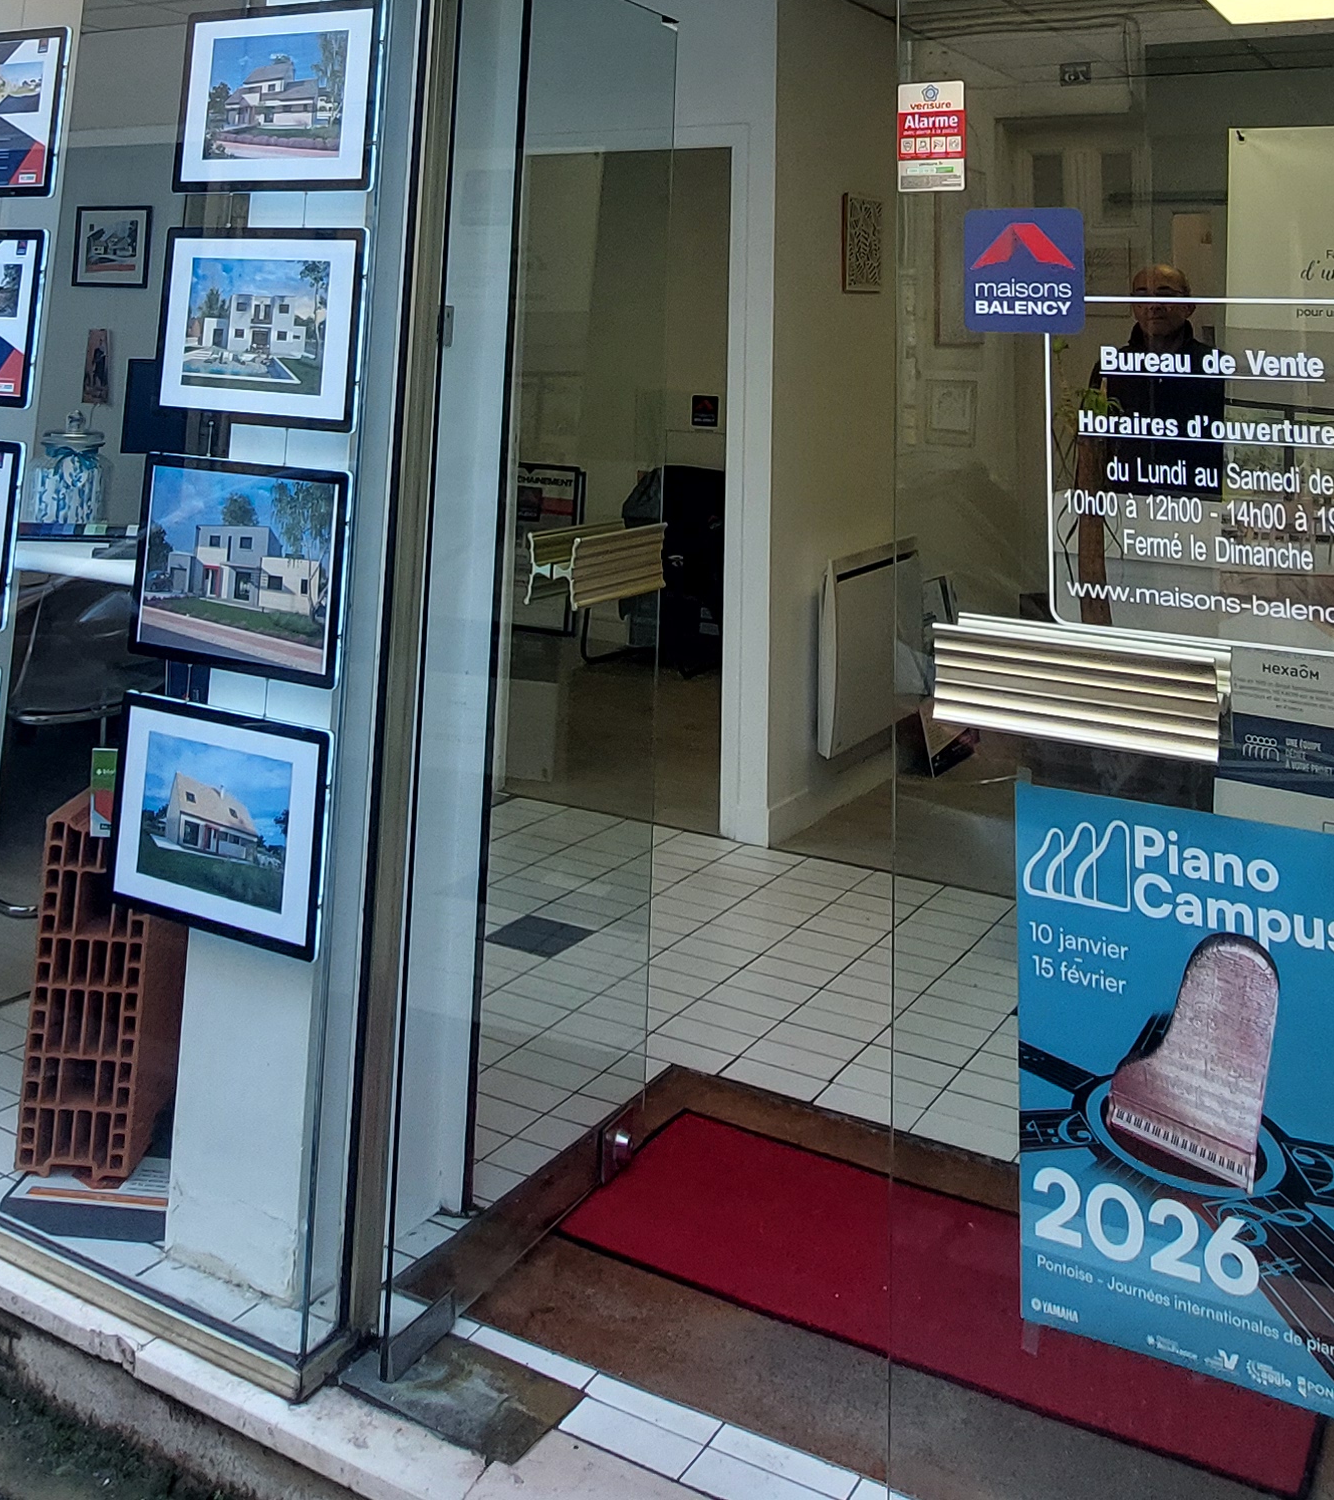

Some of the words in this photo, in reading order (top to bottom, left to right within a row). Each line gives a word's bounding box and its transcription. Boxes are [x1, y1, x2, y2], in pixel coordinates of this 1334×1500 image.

[904, 114, 959, 130] Alarme
[910, 102, 951, 111] verisure
[974, 278, 1073, 298] maisons
[975, 300, 1072, 315] BALENCY
[1296, 308, 1324, 319] pour
[1100, 346, 1192, 373] Bureau
[1201, 350, 1236, 375] de
[1245, 350, 1325, 378] Vente
[1078, 410, 1179, 437] Horaires
[1106, 457, 1129, 482] du
[1137, 458, 1187, 486] Lundi
[1195, 466, 1218, 488] au
[1226, 463, 1301, 494] Samedi
[1309, 469, 1334, 496] de
[1063, 489, 1118, 517] 10h00
[1125, 498, 1138, 519] à
[1146, 494, 1203, 523] 12h00
[1227, 501, 1286, 530] 14h00
[1295, 505, 1308, 532] à
[1123, 529, 1183, 559] Fermé
[1190, 534, 1207, 561] le
[1215, 537, 1314, 571] Dimanche
[1134, 825, 1279, 892] Piano
[1029, 921, 1053, 945] 10
[1058, 927, 1129, 962] janvier
[1032, 956, 1054, 979] 15
[1061, 958, 1127, 994] février
[1032, 1166, 1260, 1296] 2026
[1036, 1254, 1094, 1284] Pontoise
[1107, 1276, 1171, 1307] Journées
[1173, 1296, 1280, 1340] internationales
[1283, 1327, 1304, 1348] de
[1042, 1299, 1079, 1323] YAMAHA
